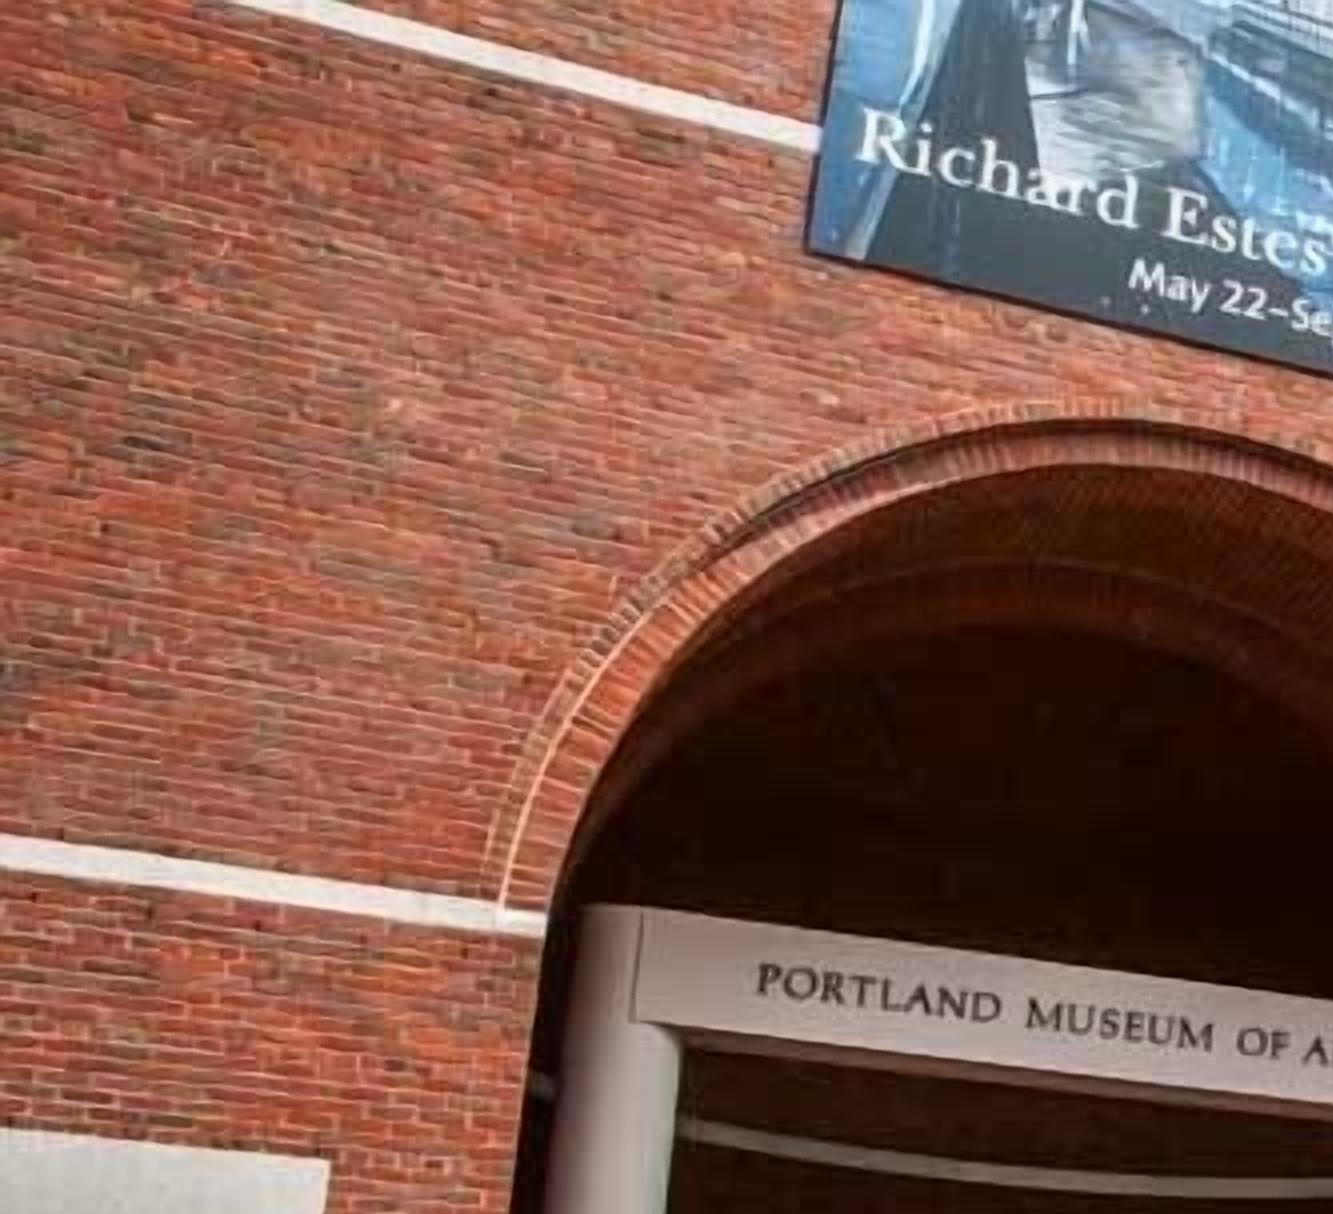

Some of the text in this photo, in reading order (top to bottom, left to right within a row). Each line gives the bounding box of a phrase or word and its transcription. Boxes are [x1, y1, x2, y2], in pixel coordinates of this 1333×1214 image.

[854, 105, 1140, 232] Richard
[1128, 256, 1211, 316] May
[755, 961, 1002, 1024] PORTLAND
[1025, 998, 1215, 1054] MUSEUM
[1235, 1025, 1290, 1060] OF
